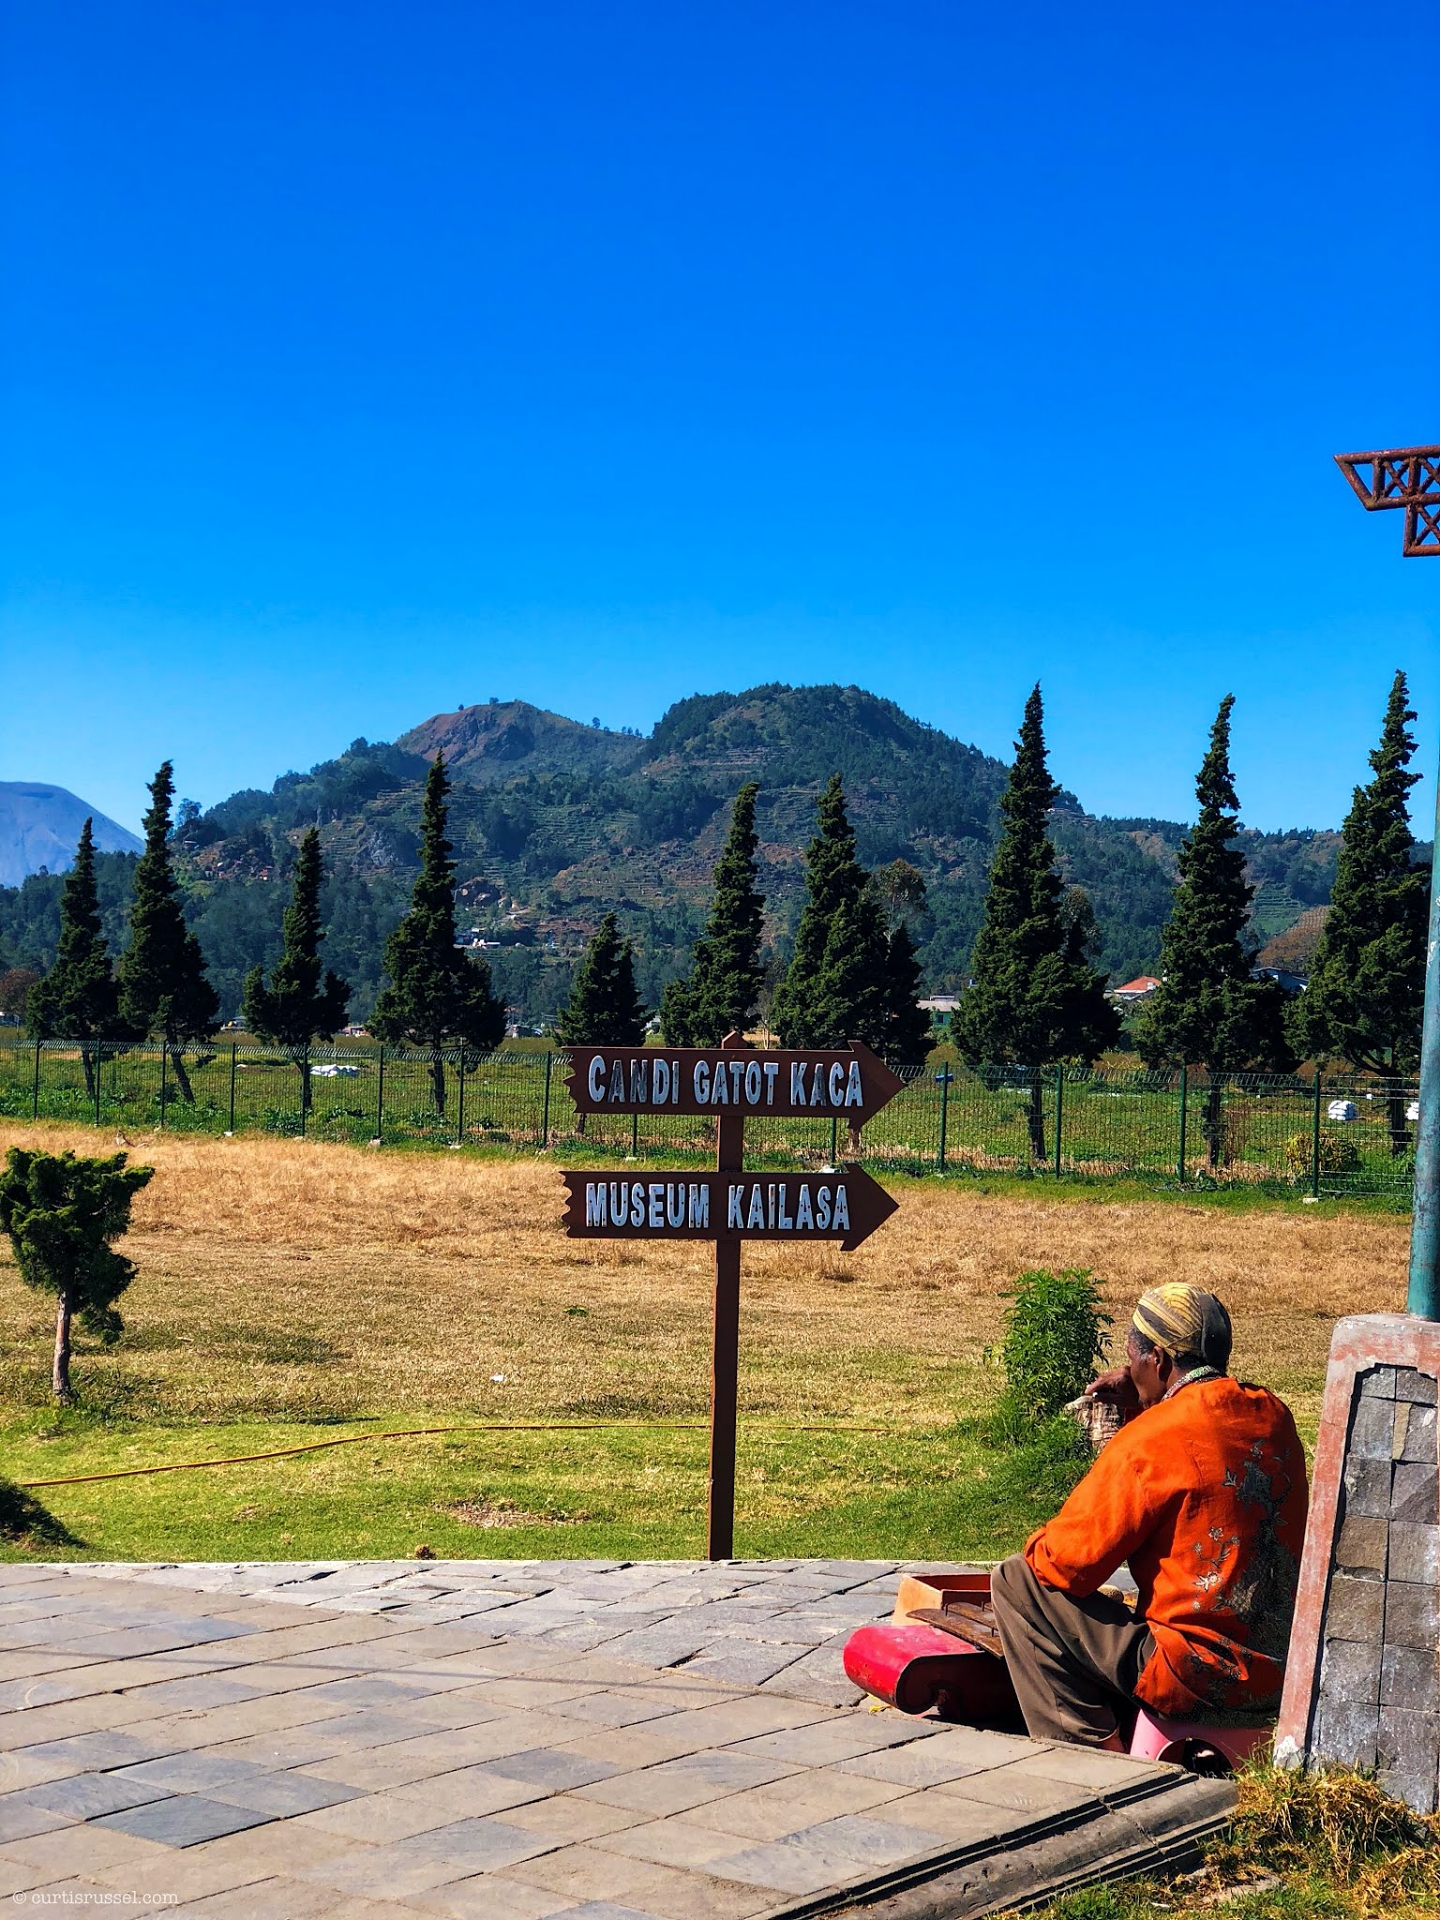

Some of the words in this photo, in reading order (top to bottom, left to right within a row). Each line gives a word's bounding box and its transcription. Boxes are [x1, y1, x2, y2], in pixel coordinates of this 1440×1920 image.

[588, 1055, 680, 1105] CANDI
[693, 1060, 779, 1105] GATOT
[790, 1061, 864, 1107] KACA
[585, 1182, 710, 1228] MUSEUM
[727, 1183, 851, 1230] KAILASA
